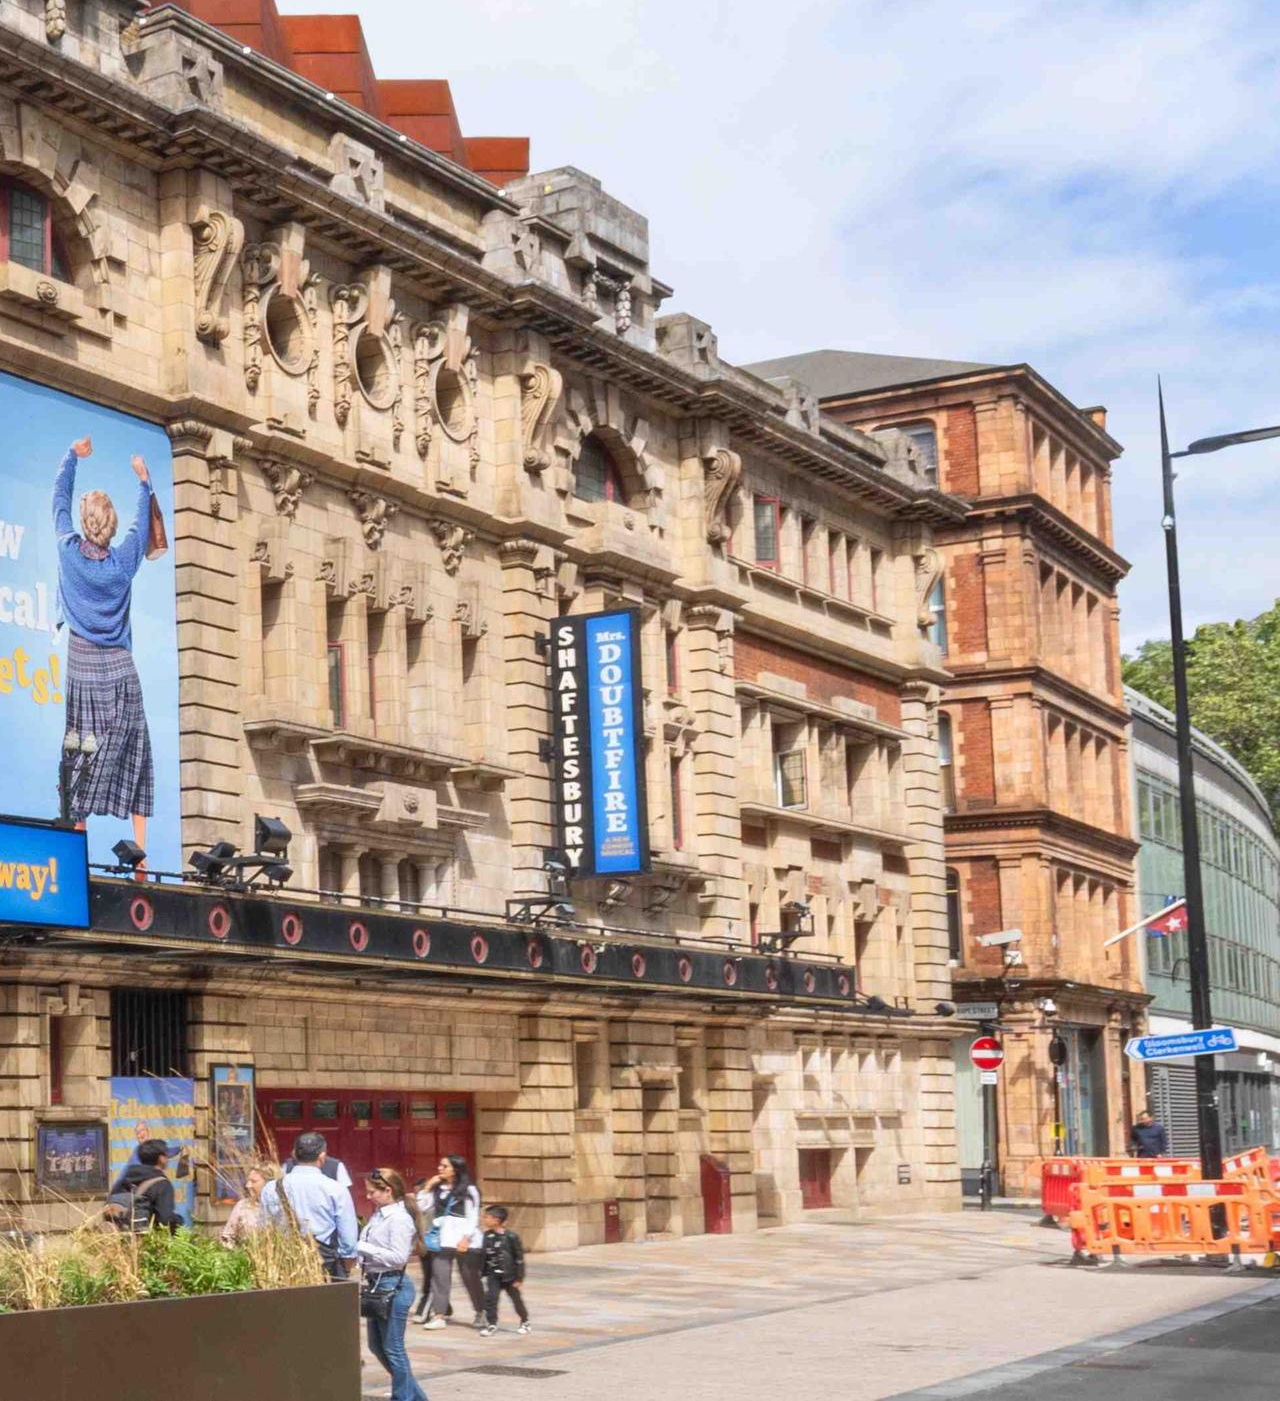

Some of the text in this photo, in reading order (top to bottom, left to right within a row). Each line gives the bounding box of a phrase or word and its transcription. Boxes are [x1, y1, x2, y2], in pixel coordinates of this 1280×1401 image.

[595, 631, 627, 643] Mrs.
[598, 643, 628, 833] DOUBTFIRE
[557, 626, 584, 868] SHAFTESBURY
[1144, 1036, 1204, 1048] Bloomsbury
[1145, 1043, 1206, 1056] Clerkenwell
